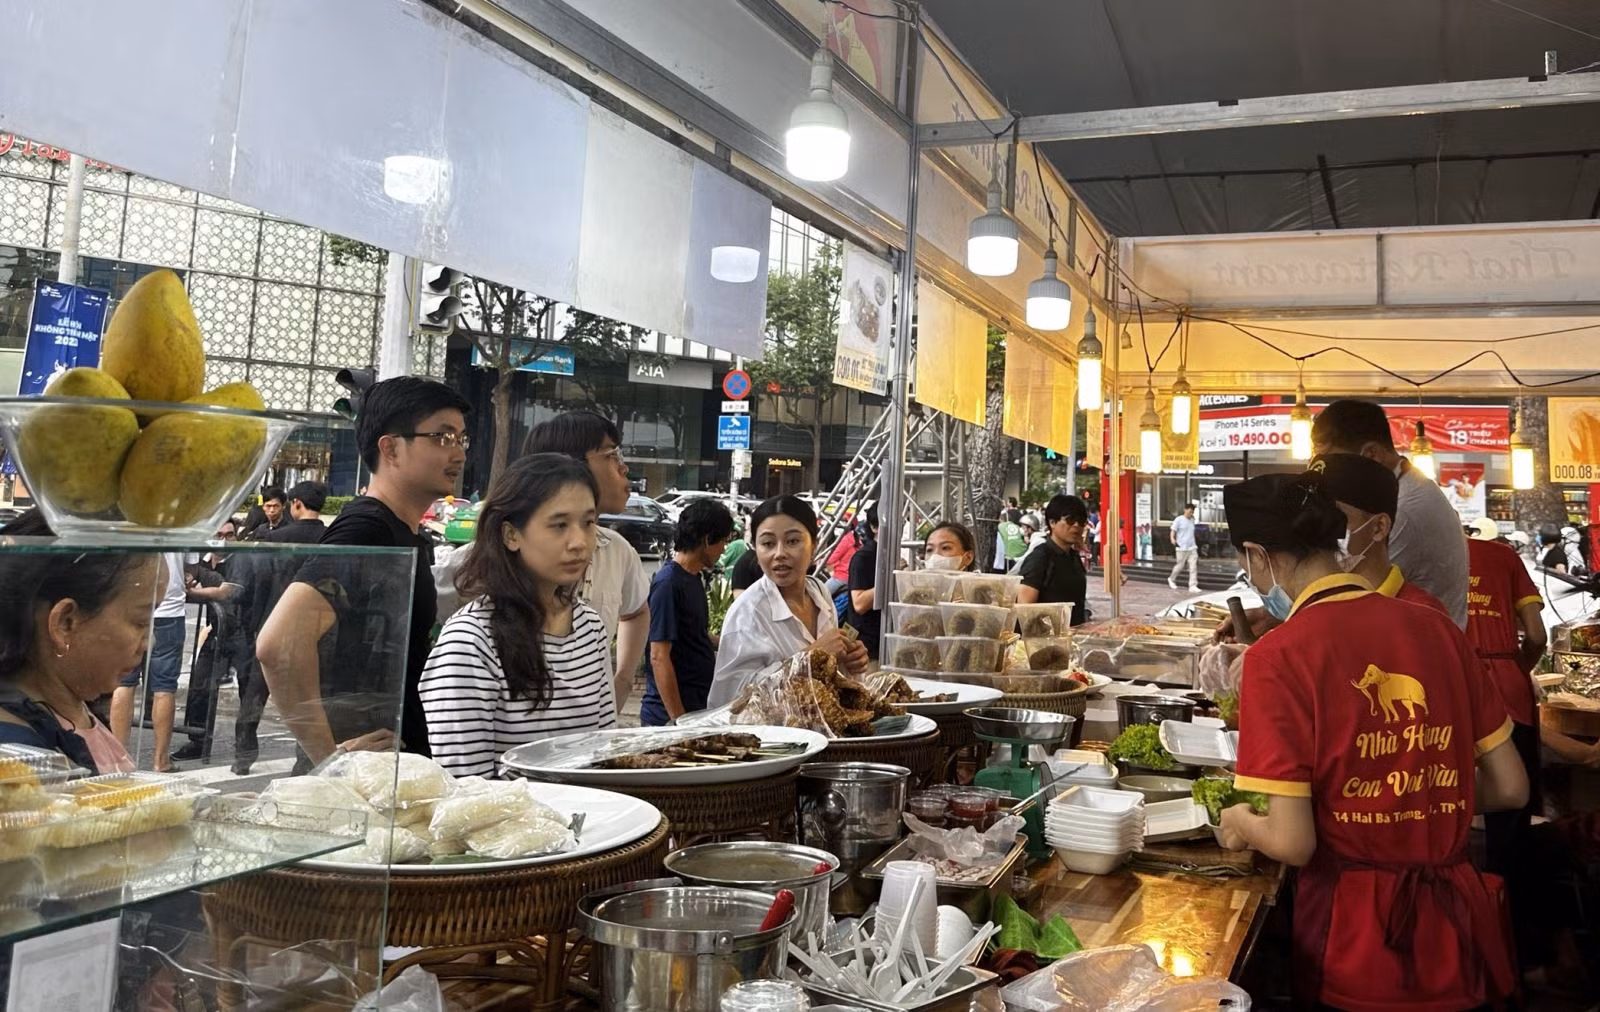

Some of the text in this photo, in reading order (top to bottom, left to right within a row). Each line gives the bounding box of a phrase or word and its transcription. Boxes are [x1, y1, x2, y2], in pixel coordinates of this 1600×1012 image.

[636, 364, 665, 379] AIA
[1214, 420, 1239, 429] iPhone
[1250, 418, 1277, 427] Series
[1228, 432, 1292, 446] 19.490.00
[1447, 430, 1469, 446] 18
[1468, 576, 1480, 587] ng
[1356, 730, 1398, 760] Nhà
[1343, 763, 1459, 798] Con Voi Vàn
[1351, 812, 1372, 824] Hai
